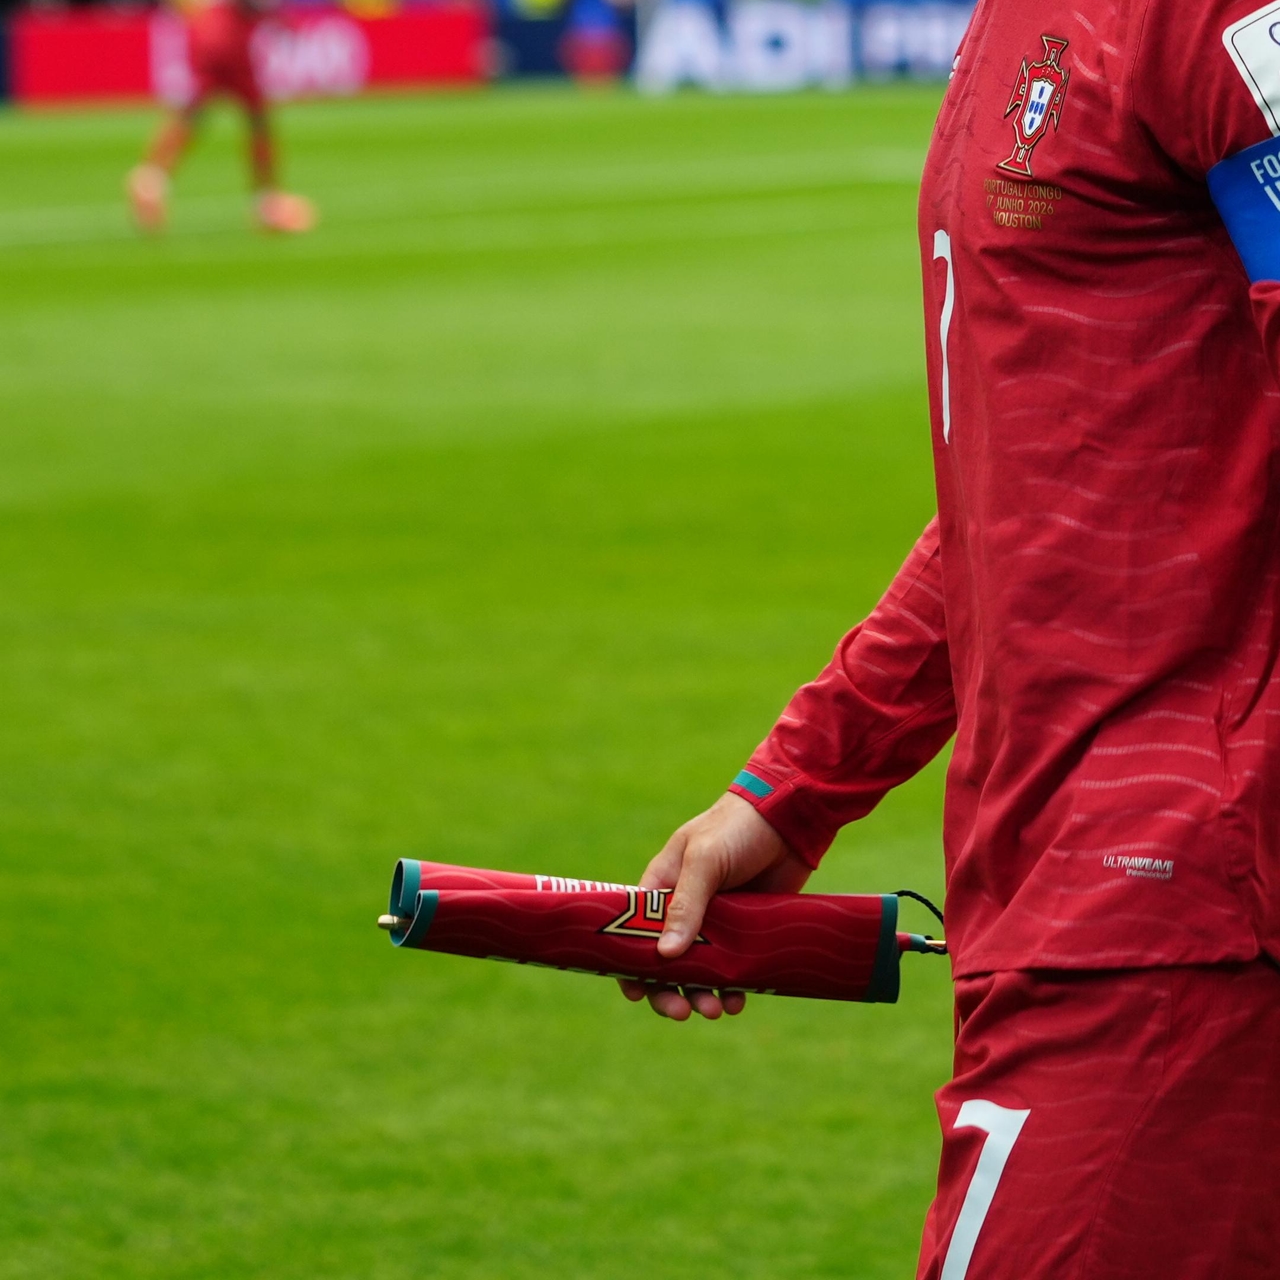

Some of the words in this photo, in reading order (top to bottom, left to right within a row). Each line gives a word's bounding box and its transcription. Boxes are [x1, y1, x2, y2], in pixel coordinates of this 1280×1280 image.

[995, 196, 1024, 212] JUNHO
[1027, 200, 1054, 215] 2026
[993, 210, 1042, 229] HOUSTON
[1103, 854, 1174, 872] ULTRAWEAVE
[940, 1099, 1031, 1280] 7
